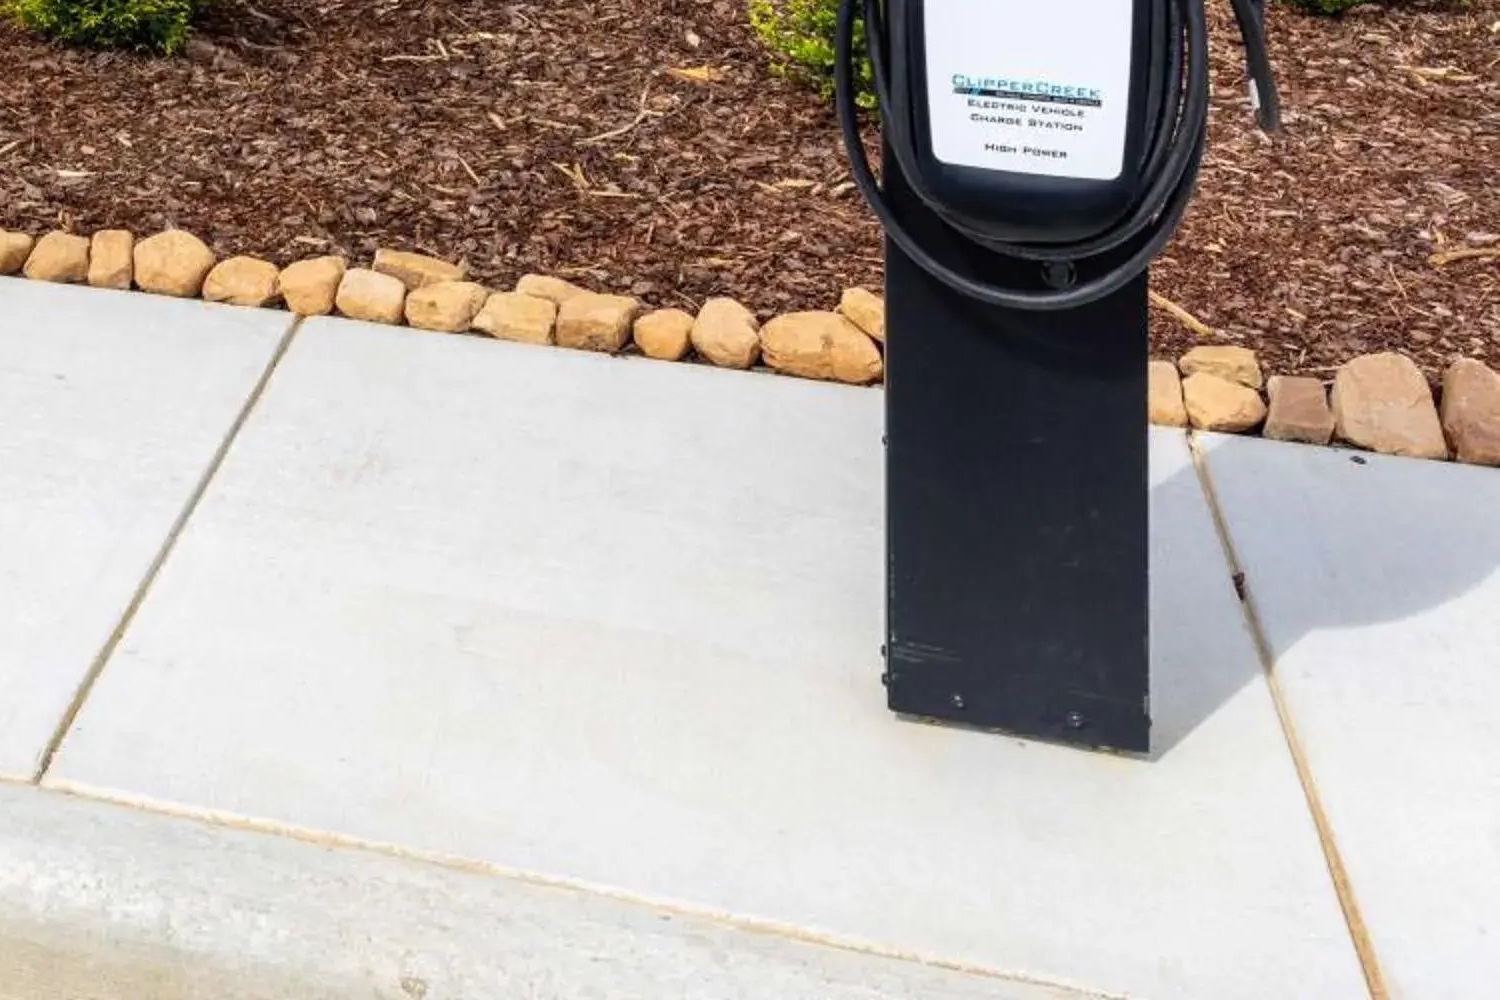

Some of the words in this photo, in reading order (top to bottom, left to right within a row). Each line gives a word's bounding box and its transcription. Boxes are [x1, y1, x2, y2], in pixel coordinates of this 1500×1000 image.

[967, 99, 1027, 112] ELECTRIC
[1031, 105, 1085, 118] VEHICLE
[970, 113, 1022, 126] CHARGE
[1028, 119, 1083, 131] STATION
[984, 143, 1017, 153] HIGH
[1023, 146, 1067, 158] POWER
